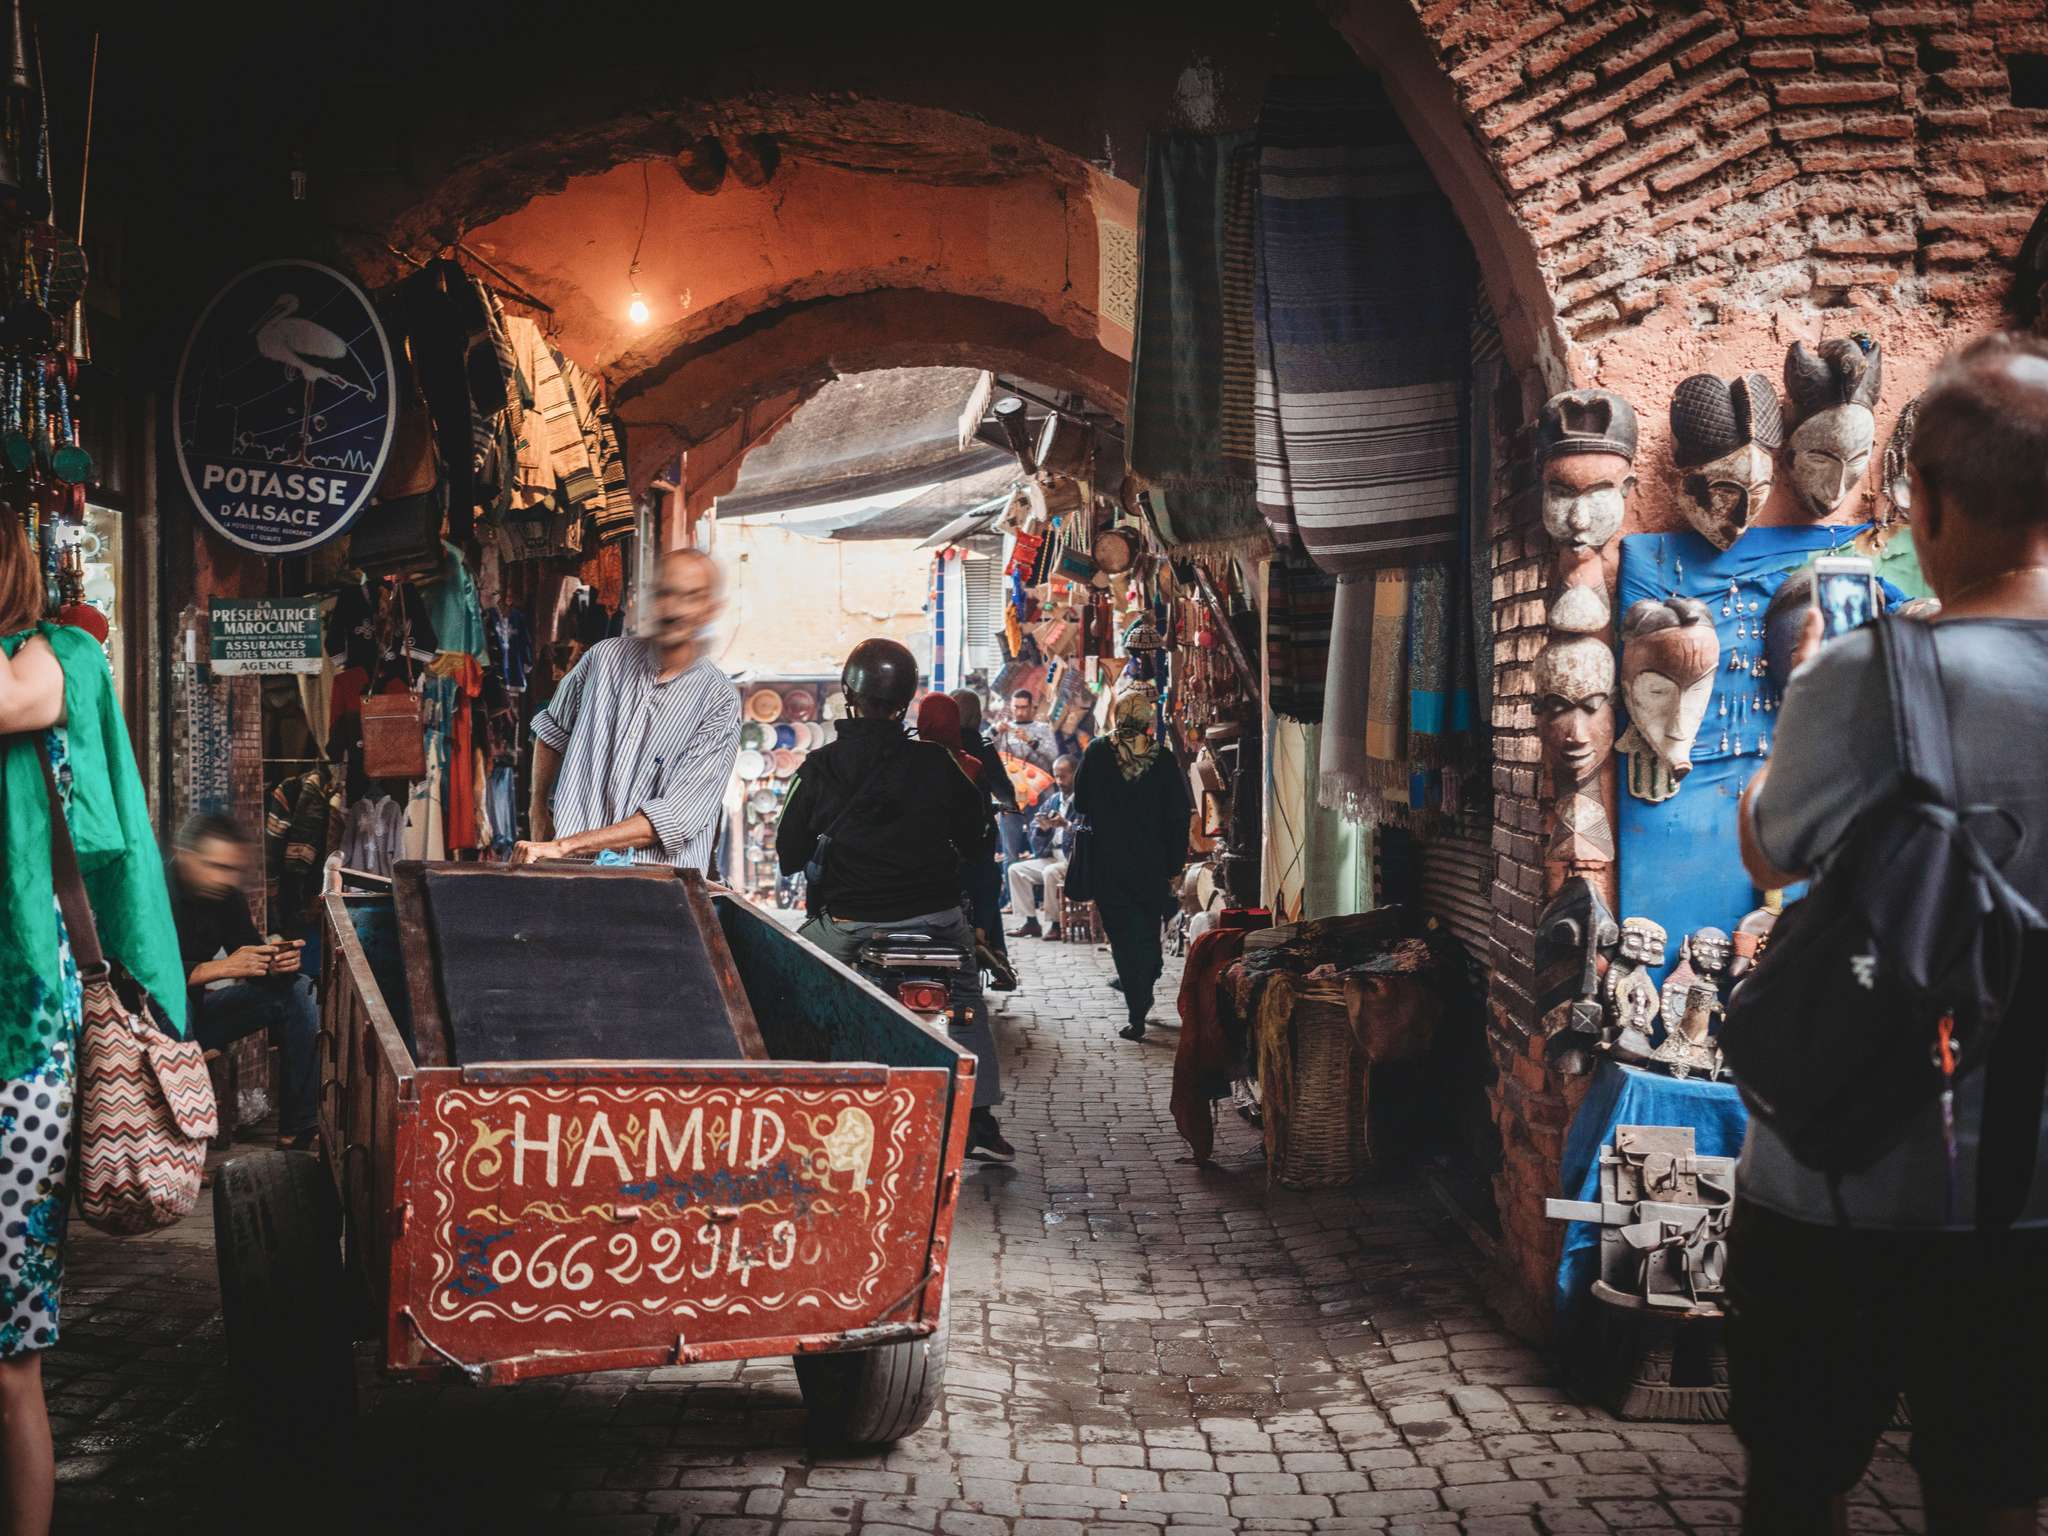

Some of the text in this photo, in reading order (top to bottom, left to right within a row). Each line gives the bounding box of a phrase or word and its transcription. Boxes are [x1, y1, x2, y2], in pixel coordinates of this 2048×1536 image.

[203, 465, 347, 505] POTASSE
[220, 501, 321, 527] D'ALSACE
[256, 600, 272, 609] LA
[212, 607, 317, 622] PRÉSERVATRICE
[224, 620, 305, 635] MAROCAINE
[225, 640, 306, 651] ASSURANCES
[225, 649, 306, 660] TOUTES BRANCHES
[239, 660, 294, 671] AGENCE
[513, 1107, 786, 1188] HAMID
